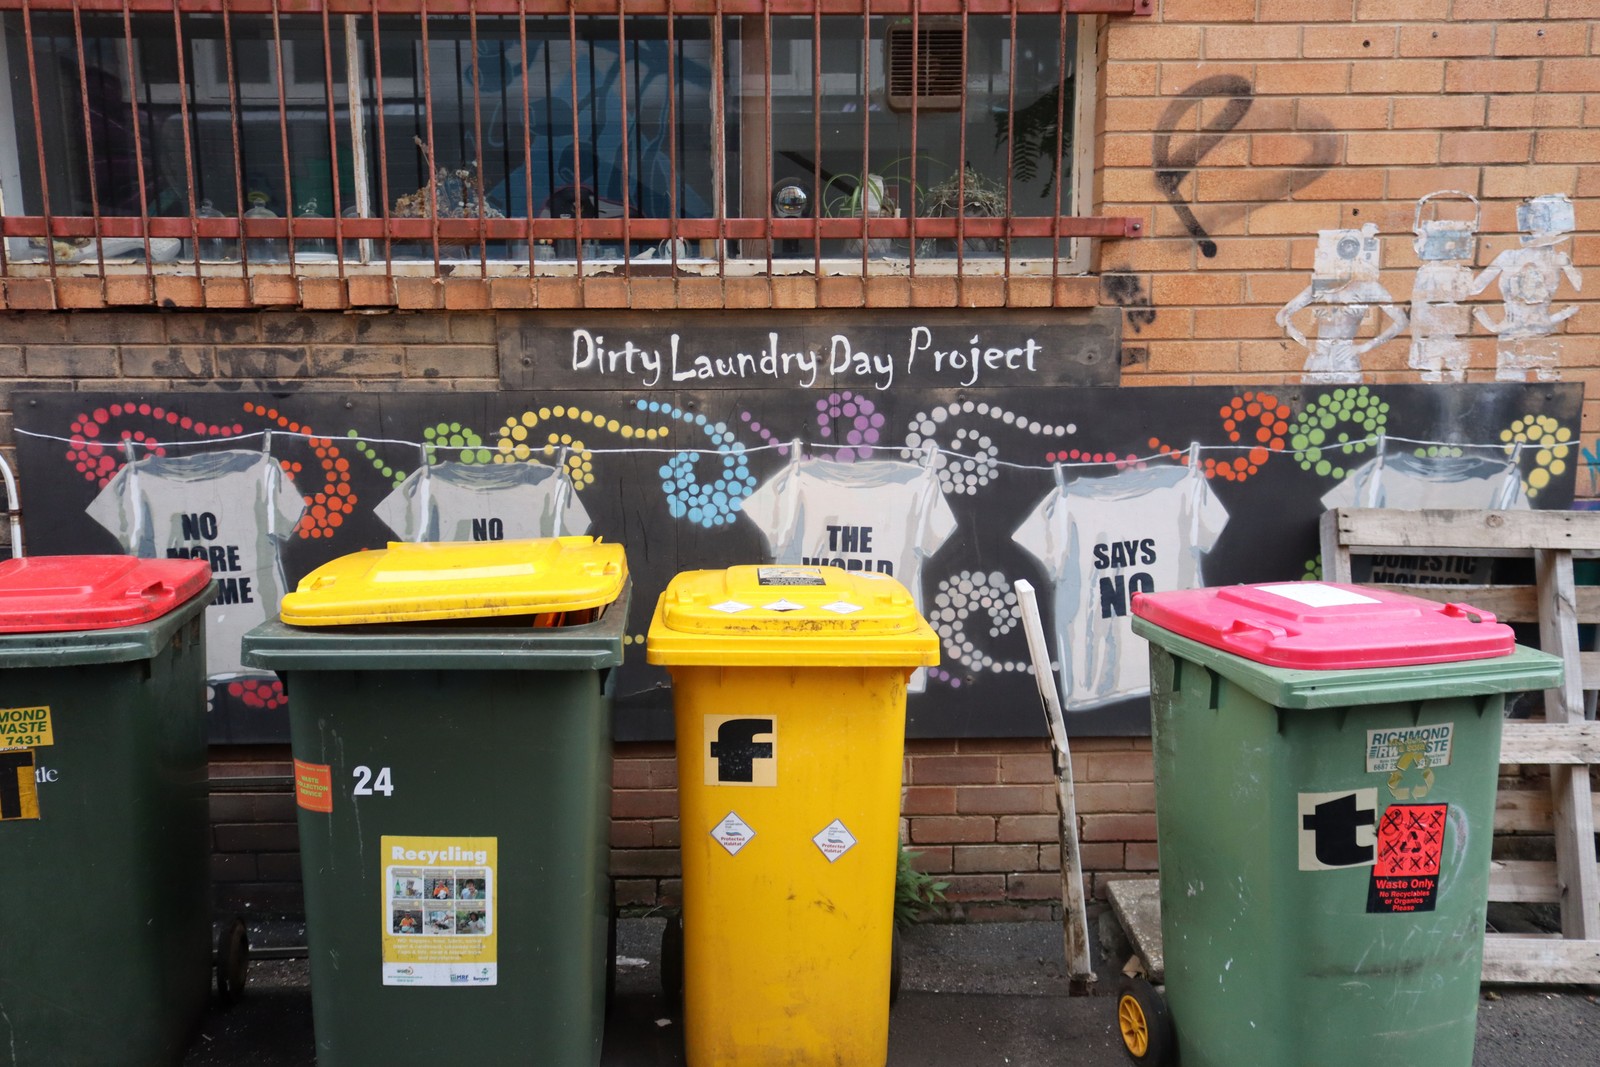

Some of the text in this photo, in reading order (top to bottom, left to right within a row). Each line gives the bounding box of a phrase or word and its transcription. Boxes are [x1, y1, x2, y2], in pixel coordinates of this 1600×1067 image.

[572, 326, 1042, 390] Dirty Laundry Day Project
[181, 512, 218, 540] NO
[472, 517, 504, 541] NO
[826, 525, 873, 553] THE
[1093, 538, 1157, 570] SAYS
[1099, 572, 1155, 619] NO
[5, 735, 41, 746] 7431
[1372, 726, 1450, 746] RICHMOND
[352, 765, 394, 797] 24
[391, 846, 487, 864] Recycling
[1376, 879, 1408, 889] Waste
[1391, 890, 1430, 899] Recyclables
[1393, 897, 1424, 906] Organics
